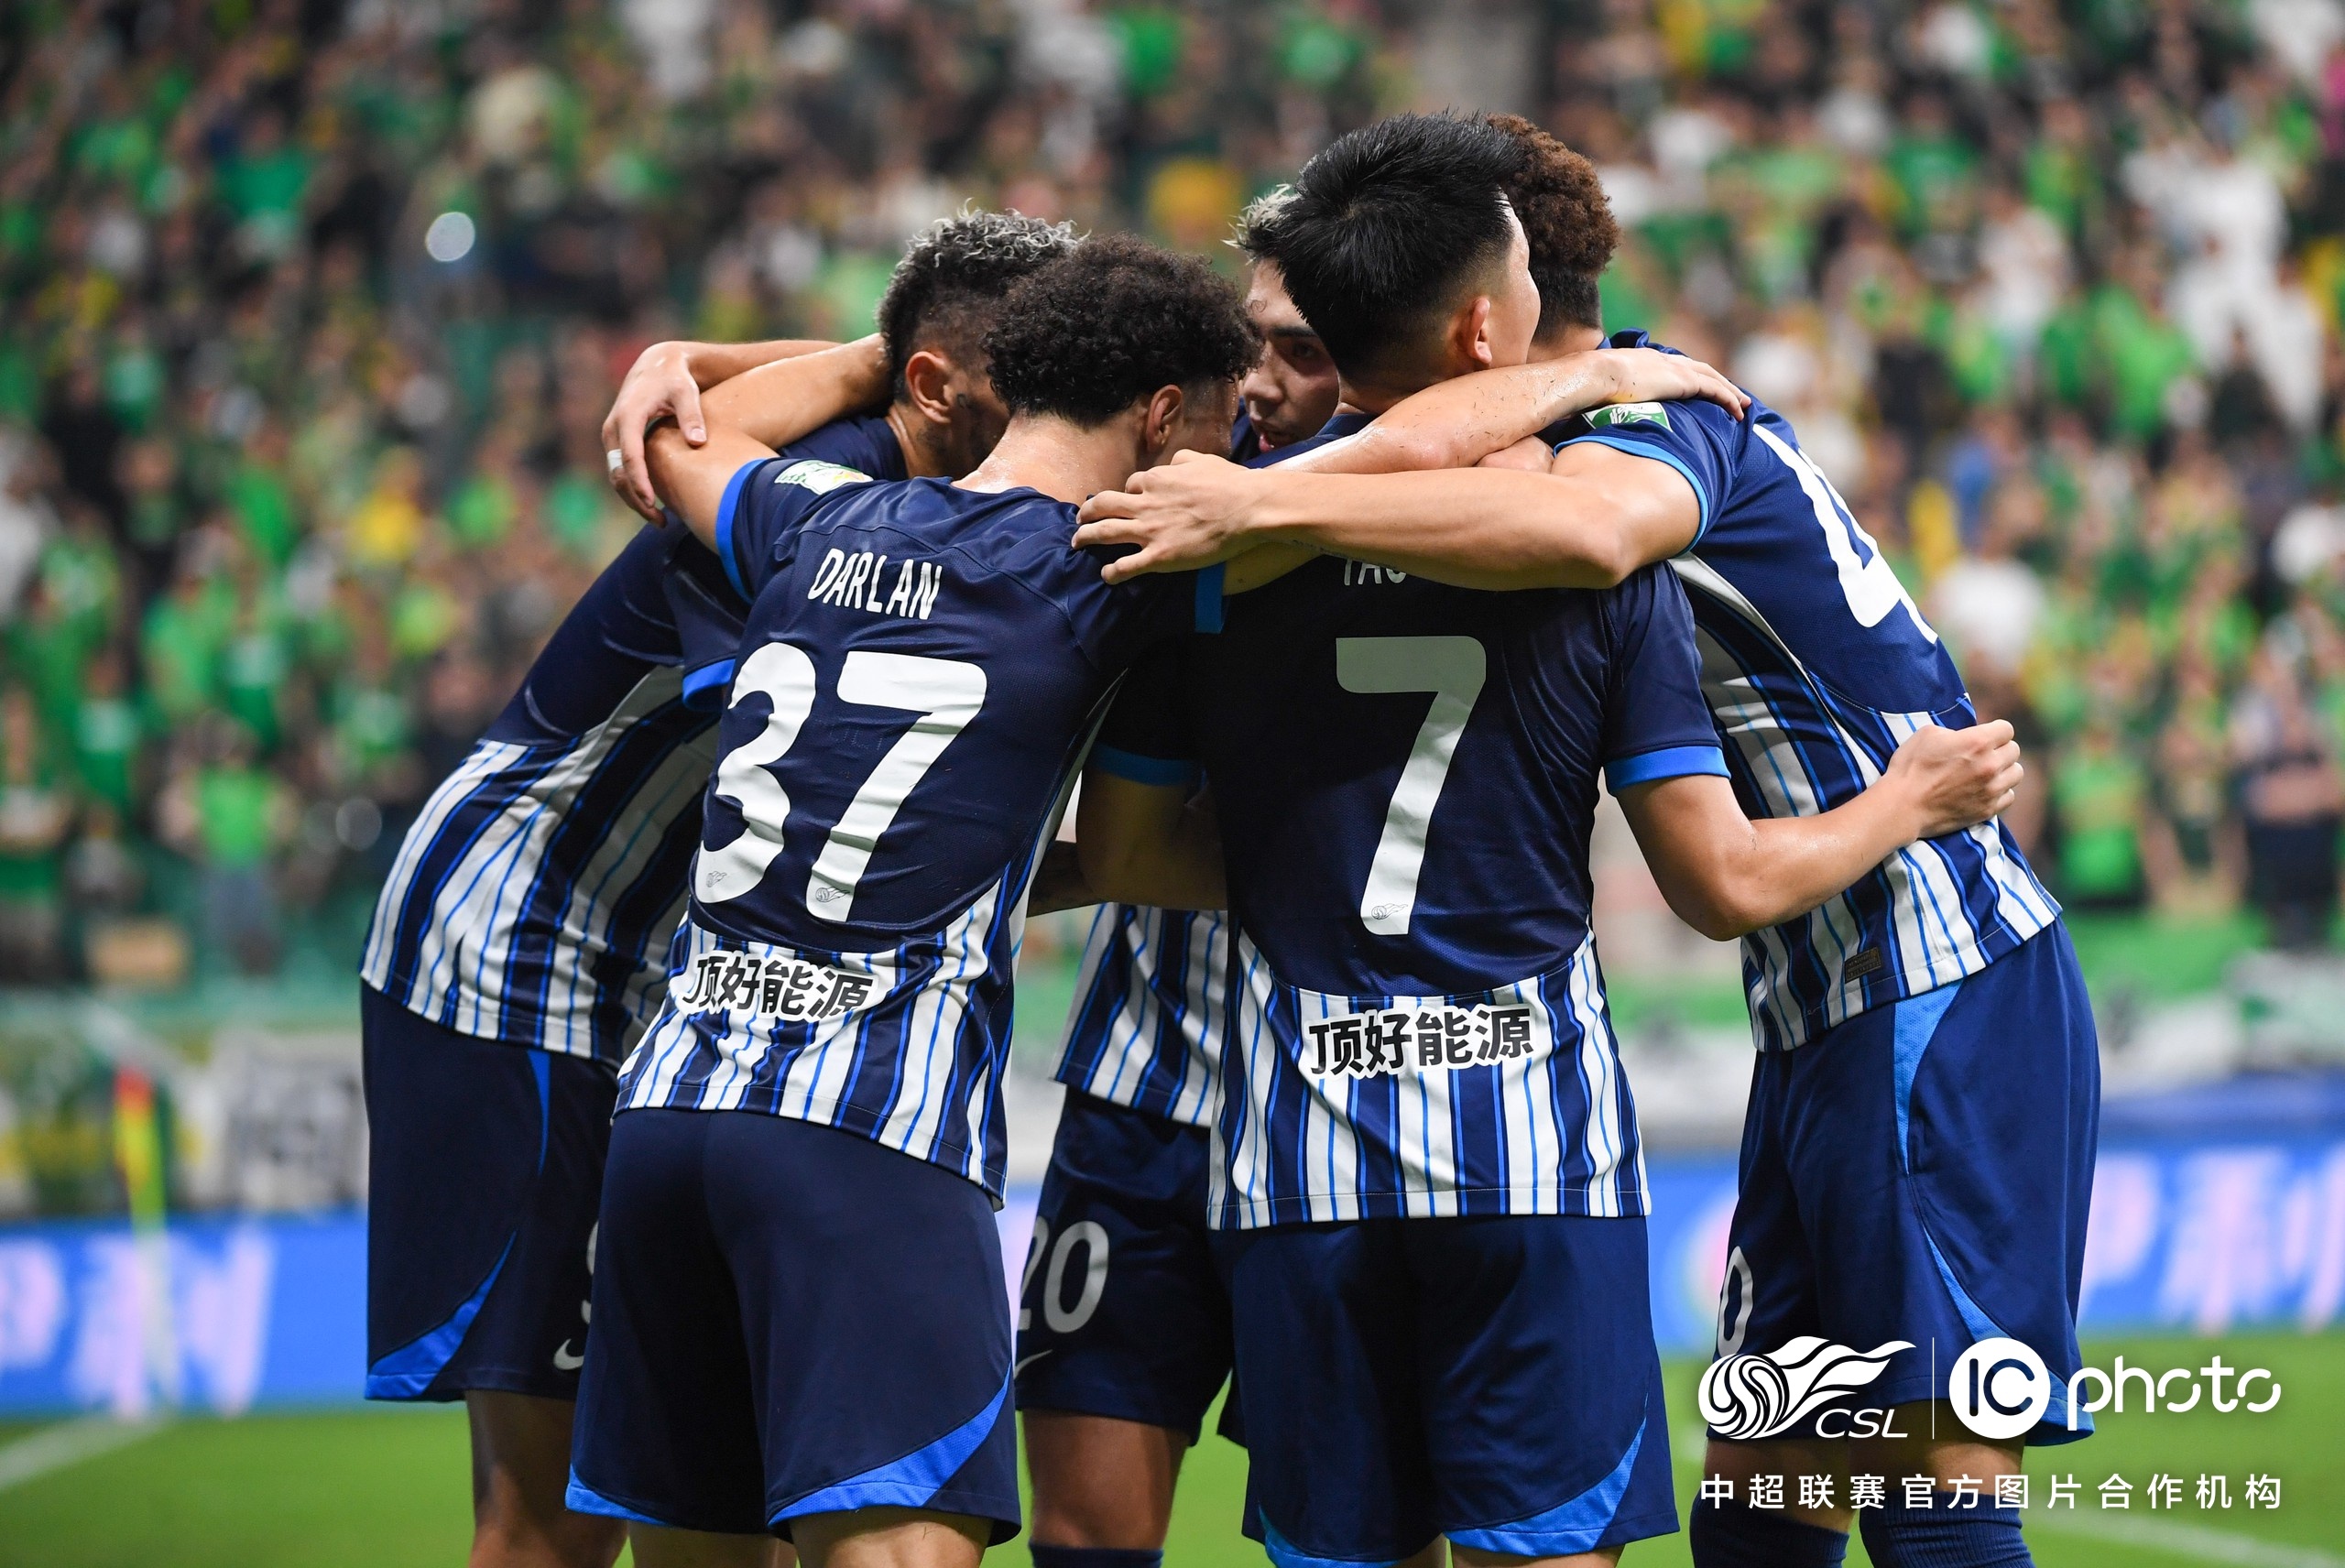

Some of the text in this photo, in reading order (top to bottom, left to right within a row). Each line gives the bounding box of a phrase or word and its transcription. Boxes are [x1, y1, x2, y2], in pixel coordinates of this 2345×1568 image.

[807, 548, 943, 620] DARLAN
[694, 641, 987, 922] 37
[1336, 636, 1487, 935] 7
[682, 956, 873, 1019] 顶好能源
[1308, 1008, 1536, 1075] 顶好能源
